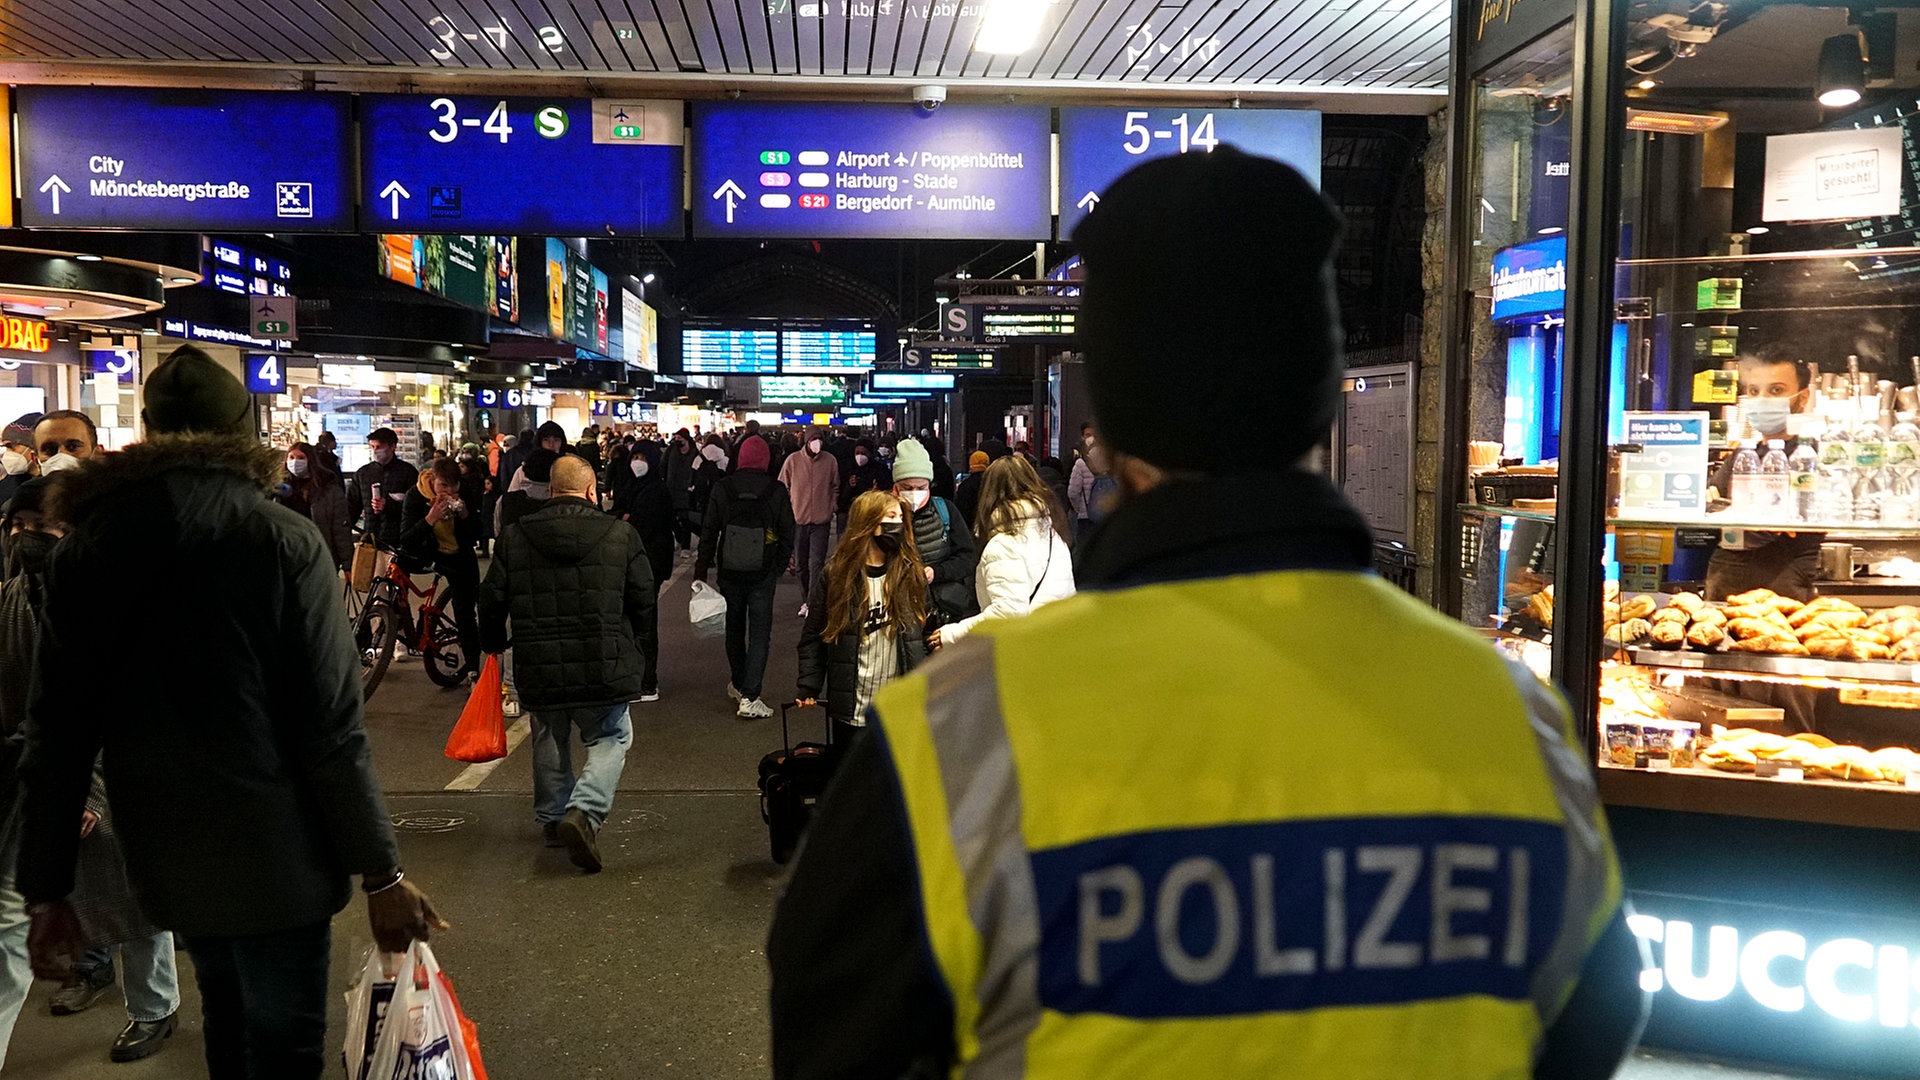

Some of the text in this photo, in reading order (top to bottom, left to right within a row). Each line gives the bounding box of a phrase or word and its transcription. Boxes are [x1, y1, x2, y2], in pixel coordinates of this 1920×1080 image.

[428, 97, 565, 144] 3-4 S
[1122, 110, 1219, 155] 5-14
[89, 155, 124, 177] City
[836, 151, 890, 170] Airport
[921, 151, 1024, 170] Poppenbüttel
[1819, 157, 1876, 173] Mitarbeiter
[89, 180, 250, 202] Mönckebergstraße
[836, 172, 898, 192] Harburg
[913, 172, 958, 189] Stade
[836, 194, 913, 213] Bergedorf
[928, 194, 996, 211] Aumühle
[947, 307, 968, 333] S
[905, 350, 920, 366] S
[258, 355, 281, 386] 4
[507, 389, 521, 406] 6
[598, 400, 607, 414] 7
[618, 402, 627, 415] 8
[1077, 844, 1531, 987] POLIZEI
